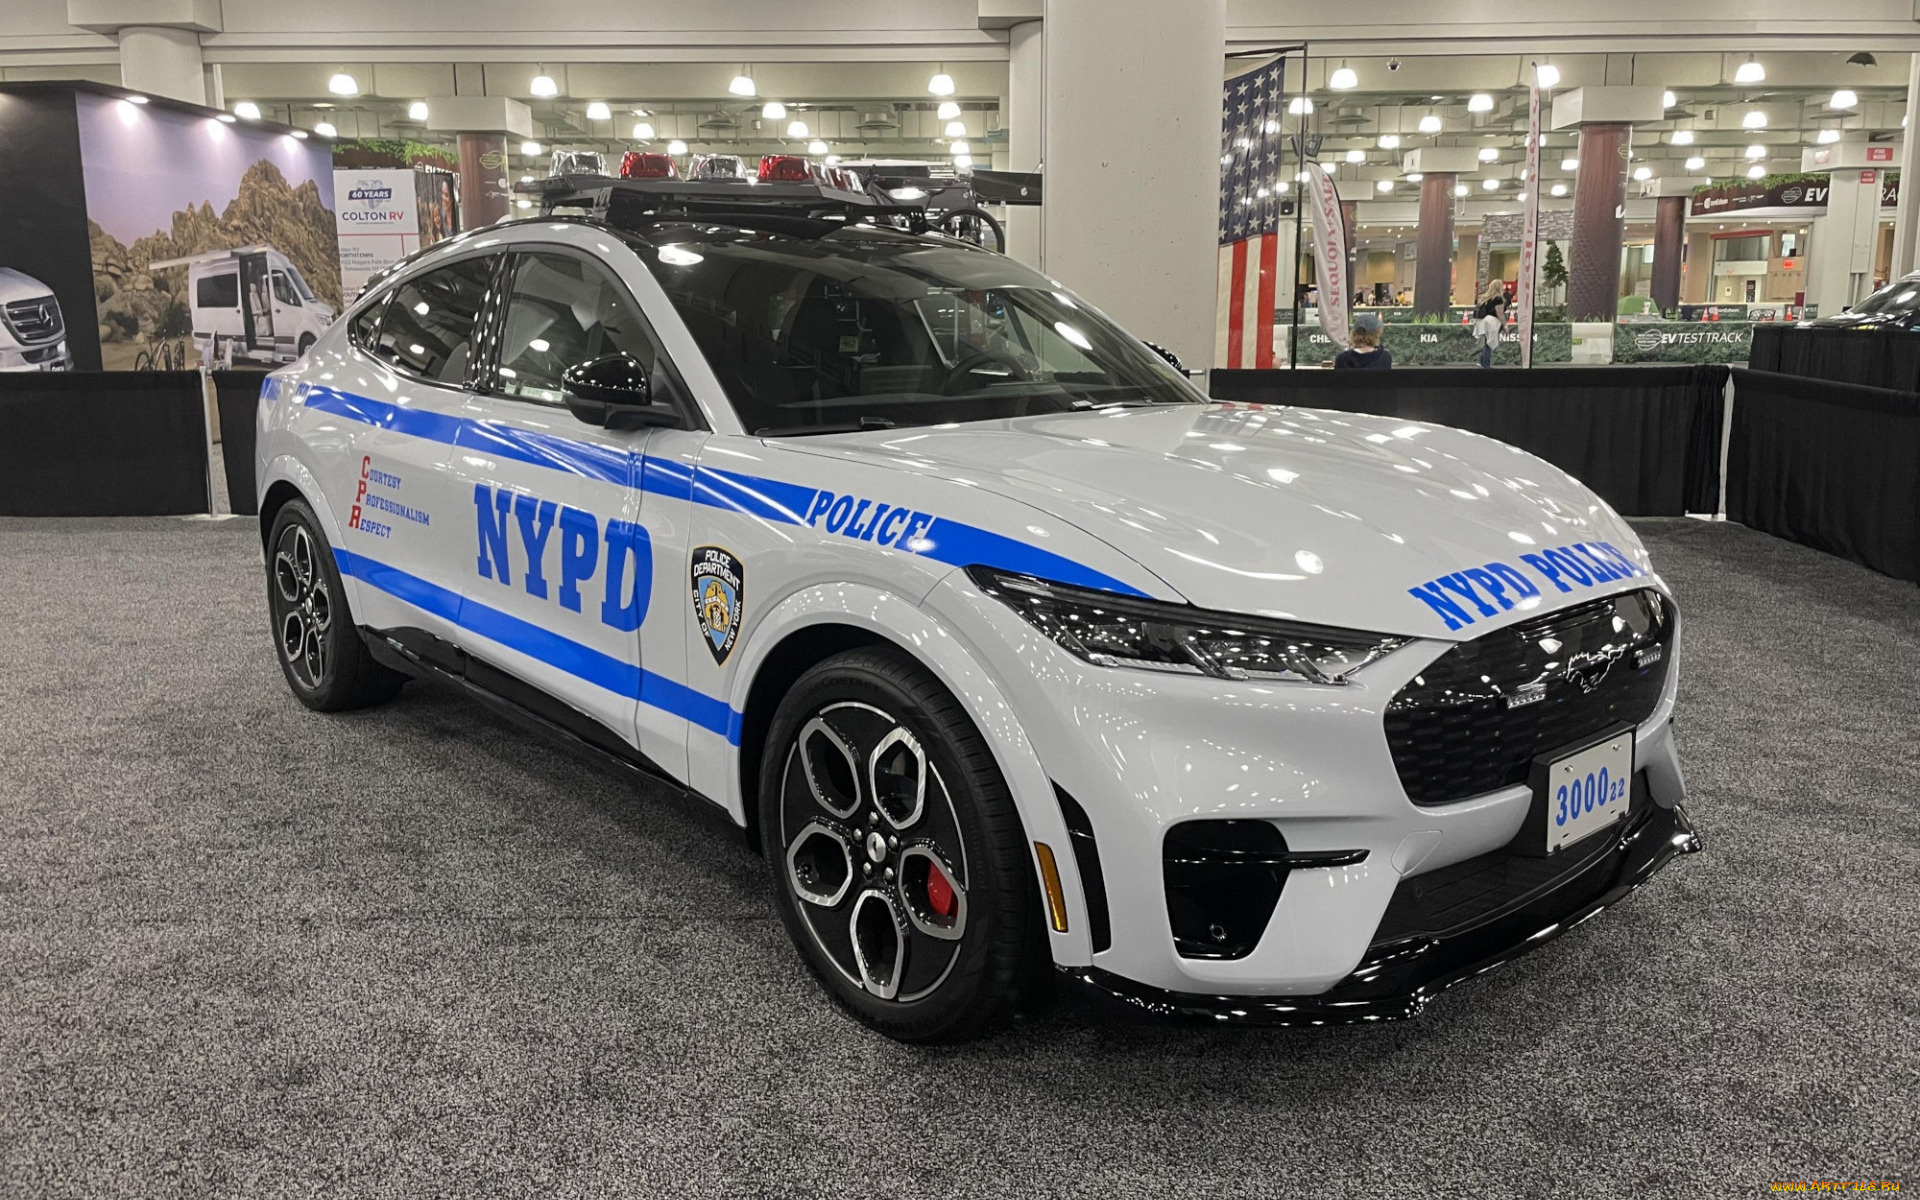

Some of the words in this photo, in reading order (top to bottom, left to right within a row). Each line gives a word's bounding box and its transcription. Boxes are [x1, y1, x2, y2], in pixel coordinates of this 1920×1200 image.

[364, 190, 389, 198] YEARS
[1805, 187, 1828, 202] EV
[342, 211, 387, 221] COLTON
[389, 211, 404, 220] RV
[1420, 334, 1438, 343] KIA
[1500, 333, 1538, 342] NISSN
[1661, 333, 1677, 344] EV
[1678, 333, 1706, 344] TEST
[1706, 332, 1743, 343] TRACK
[806, 490, 933, 553] POLICE
[474, 483, 653, 632] NYPD
[705, 550, 731, 569] POLICE
[693, 561, 741, 591] DEPARTMENT
[1407, 562, 1542, 631] NYPD
[693, 589, 703, 618] CITY
[701, 621, 711, 638] OF
[725, 628, 736, 651] NEW
[732, 600, 741, 627] YORK
[1556, 766, 1608, 827] 3000
